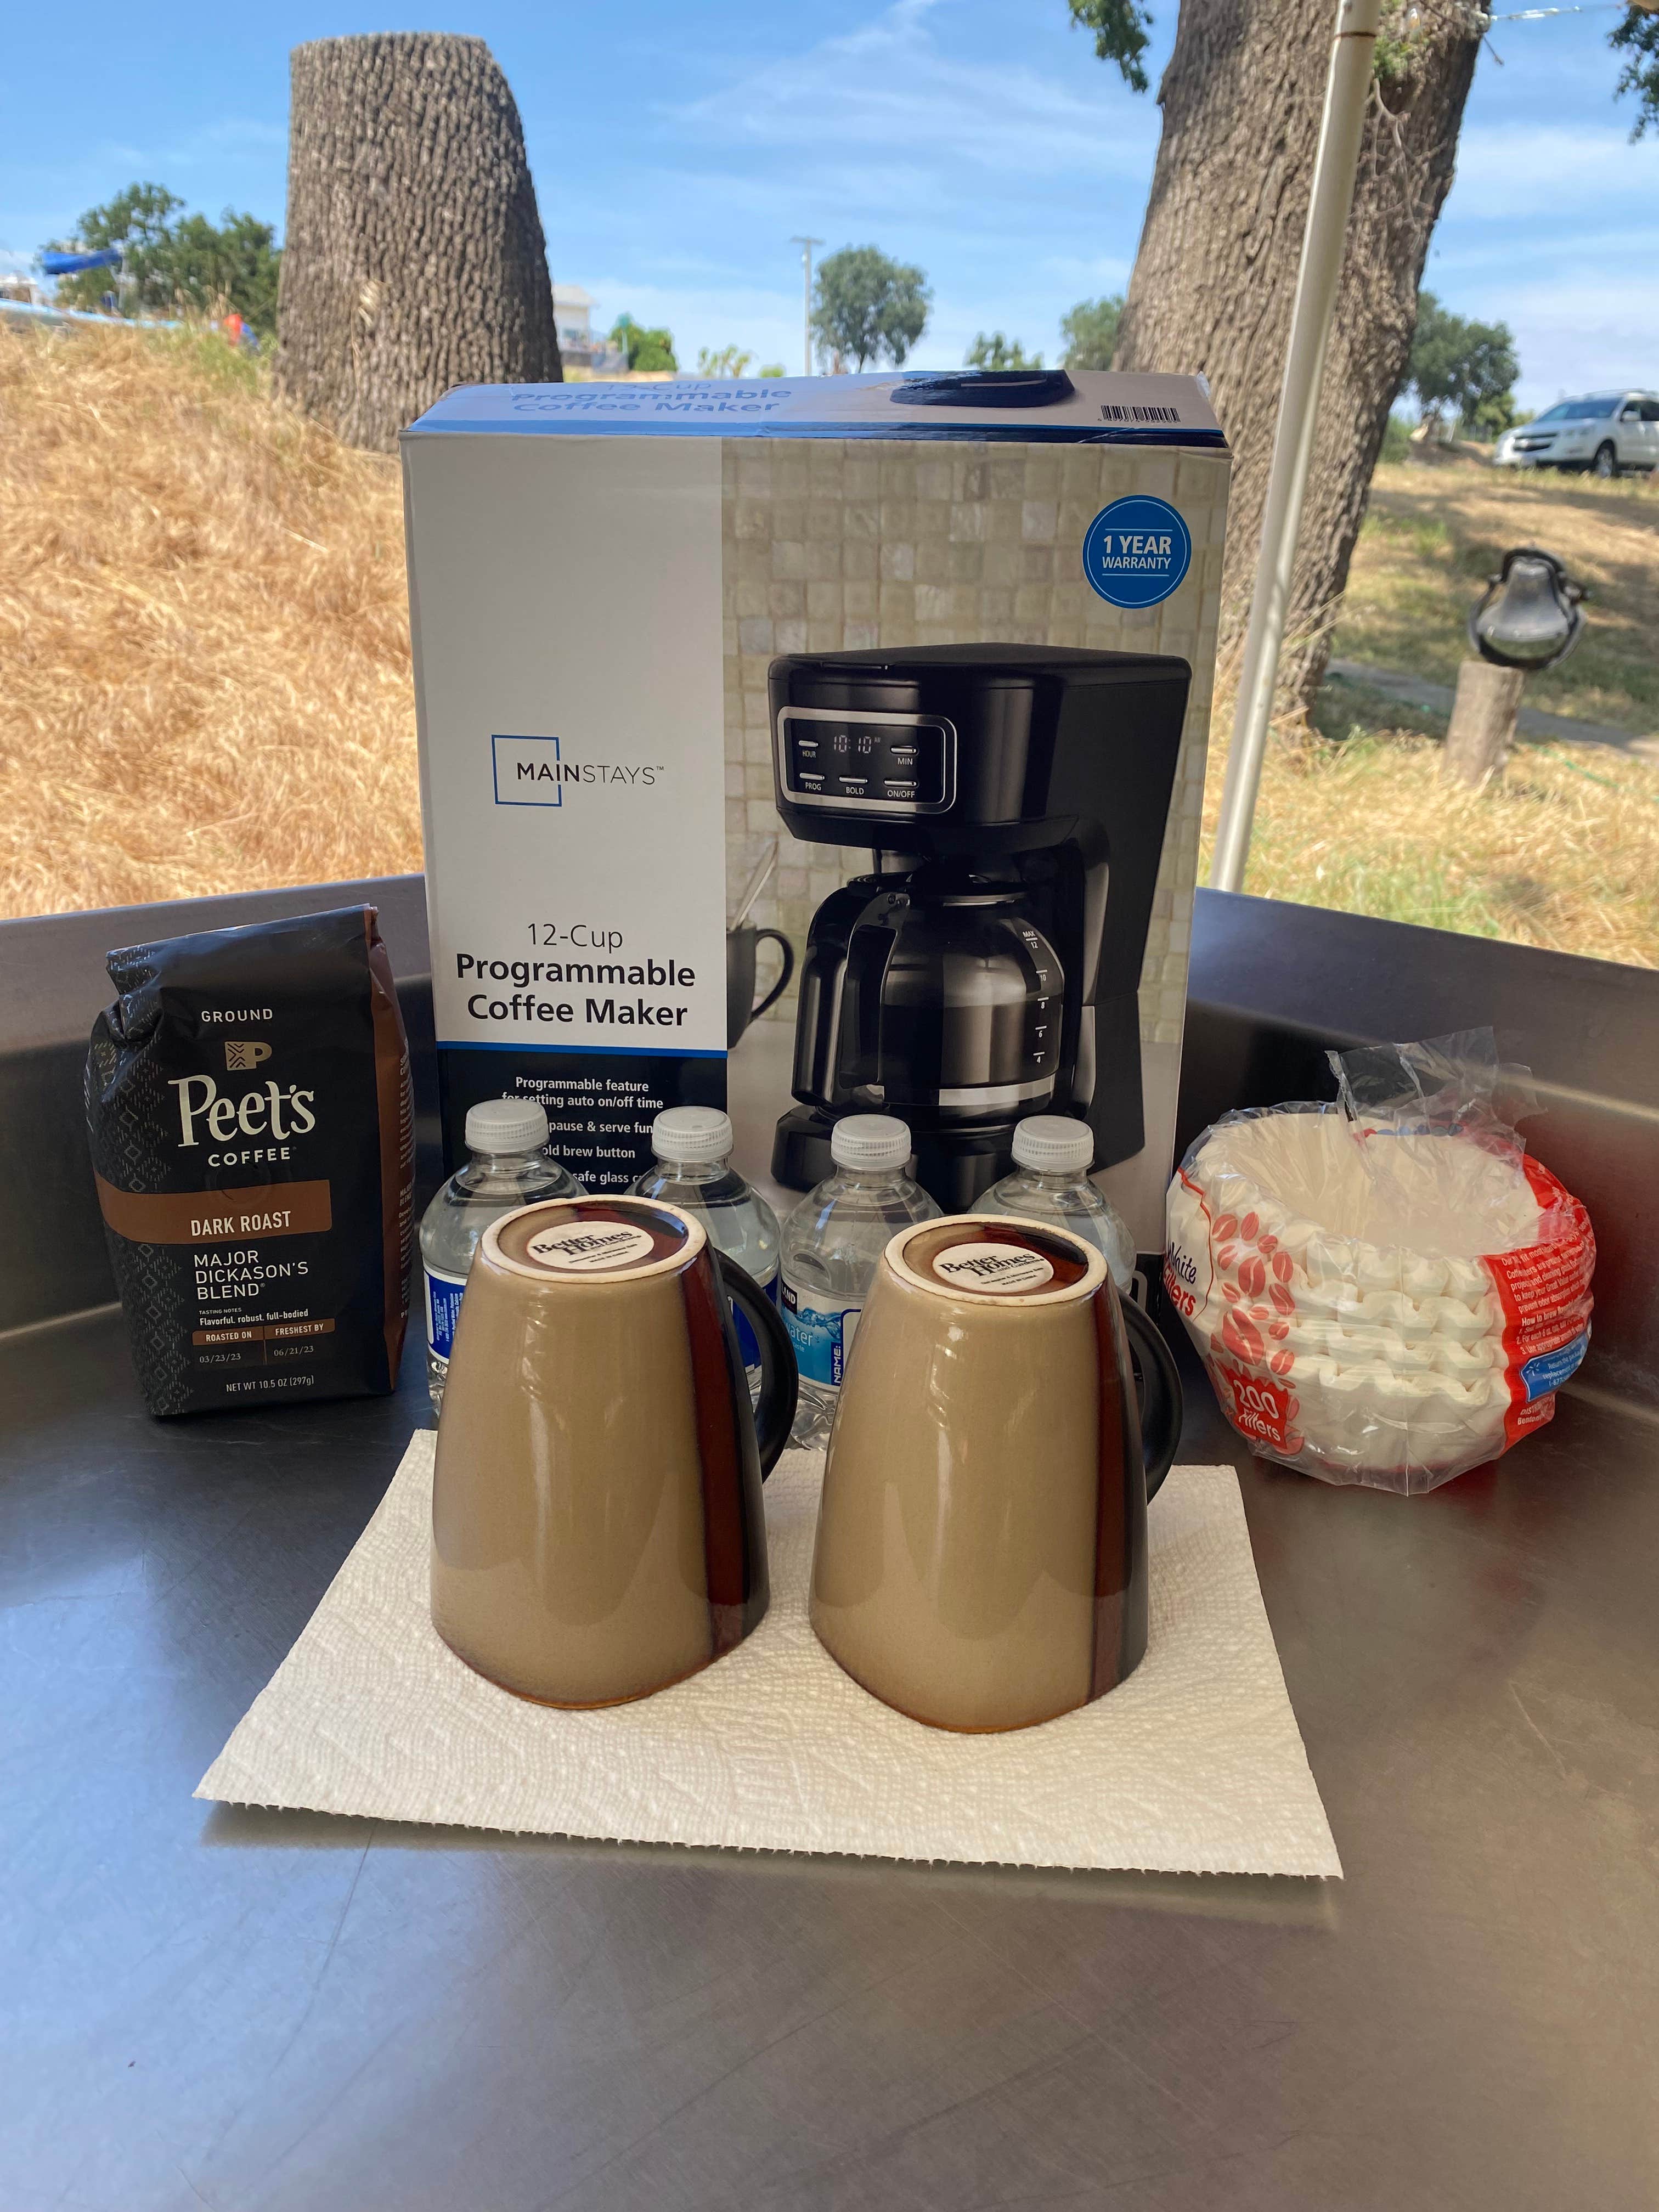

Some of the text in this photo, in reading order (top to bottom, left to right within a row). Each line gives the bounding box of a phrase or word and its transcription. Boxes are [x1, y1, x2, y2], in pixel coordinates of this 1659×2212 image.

[511, 389, 792, 401] Programmable
[513, 402, 780, 412] Coffee Maker
[1103, 535, 1172, 554] 1 YEAR
[1102, 556, 1172, 569] WARRANTY
[802, 750, 816, 758] HOUR
[805, 782, 821, 791] PROG
[845, 786, 864, 795] BOLD
[887, 790, 915, 798] ON/OFF
[528, 923, 623, 953] 12-Cup
[456, 953, 696, 988] Programmable
[201, 1008, 273, 1023] GROUND
[467, 994, 688, 1026] Coffee Maker
[1039, 1030, 1043, 1038] 6
[1036, 1056, 1041, 1064] 4
[516, 1077, 649, 1092] Programmable feature
[567, 1096, 595, 1107] auto
[598, 1097, 634, 1108] on/off
[636, 1097, 664, 1109] time
[167, 1074, 316, 1147] Peet's
[549, 1122, 583, 1133] pause
[587, 1121, 596, 1132] &
[599, 1124, 631, 1133] serve
[207, 1147, 291, 1167] COFFEE
[563, 1145, 593, 1156] brew
[596, 1146, 635, 1158] button
[600, 1171, 629, 1185] glass
[191, 1210, 291, 1236] DARK ROAST
[531, 1234, 595, 1254] Better
[561, 1231, 634, 1256] Homes
[194, 1250, 259, 1267] MAJOR
[939, 1255, 997, 1273] Better
[969, 1253, 1036, 1277] Homes
[195, 1261, 309, 1284] DICKASON'S
[1514, 1293, 1521, 1302] to
[267, 1308, 308, 1321] full-bodied
[1522, 1317, 1536, 1327] How
[275, 1323, 324, 1336] FRESHEST BY
[206, 1333, 239, 1342] ROASTED
[274, 1345, 314, 1356] 06/21/23
[199, 1353, 241, 1363] 03/23/23
[226, 1375, 314, 1392] NET WT 10.5 OZ (297g)
[1233, 1379, 1279, 1419] 200
[1238, 1407, 1281, 1442] Filters
